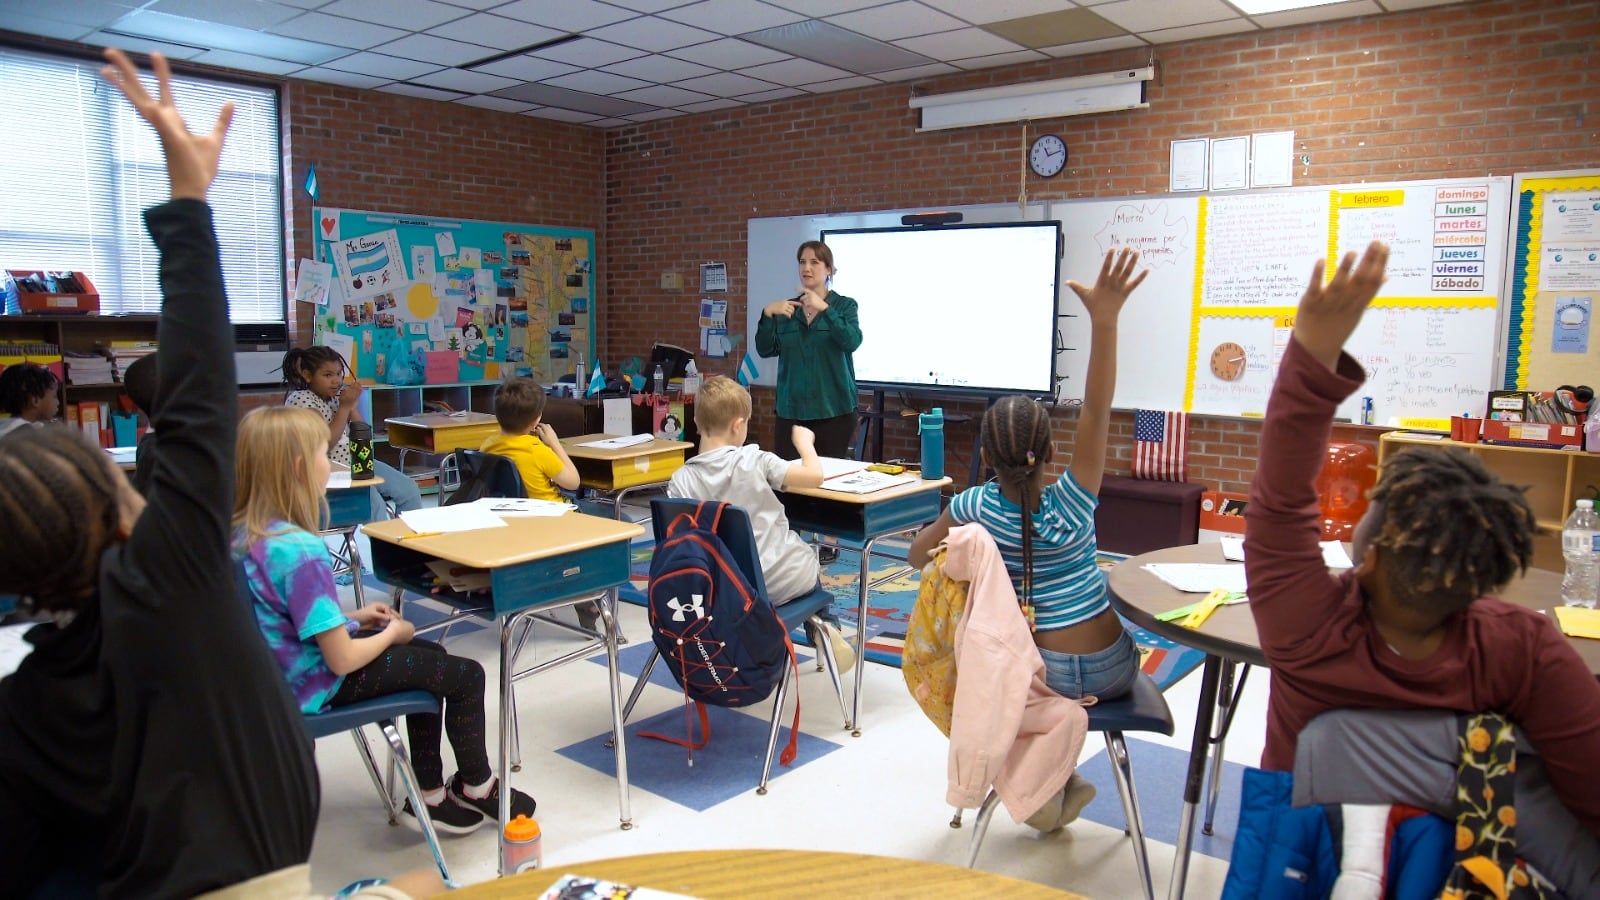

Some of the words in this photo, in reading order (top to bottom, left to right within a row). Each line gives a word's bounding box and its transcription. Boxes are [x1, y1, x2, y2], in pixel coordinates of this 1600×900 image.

[1354, 194, 1390, 204] febrero
[1438, 190, 1486, 199] domingo
[1445, 205, 1476, 214] lunes
[1440, 220, 1481, 229] martes
[1435, 235, 1484, 243] miércoles
[1440, 248, 1478, 259] jueves
[1436, 263, 1478, 273] viernes
[1435, 278, 1479, 288] sábado
